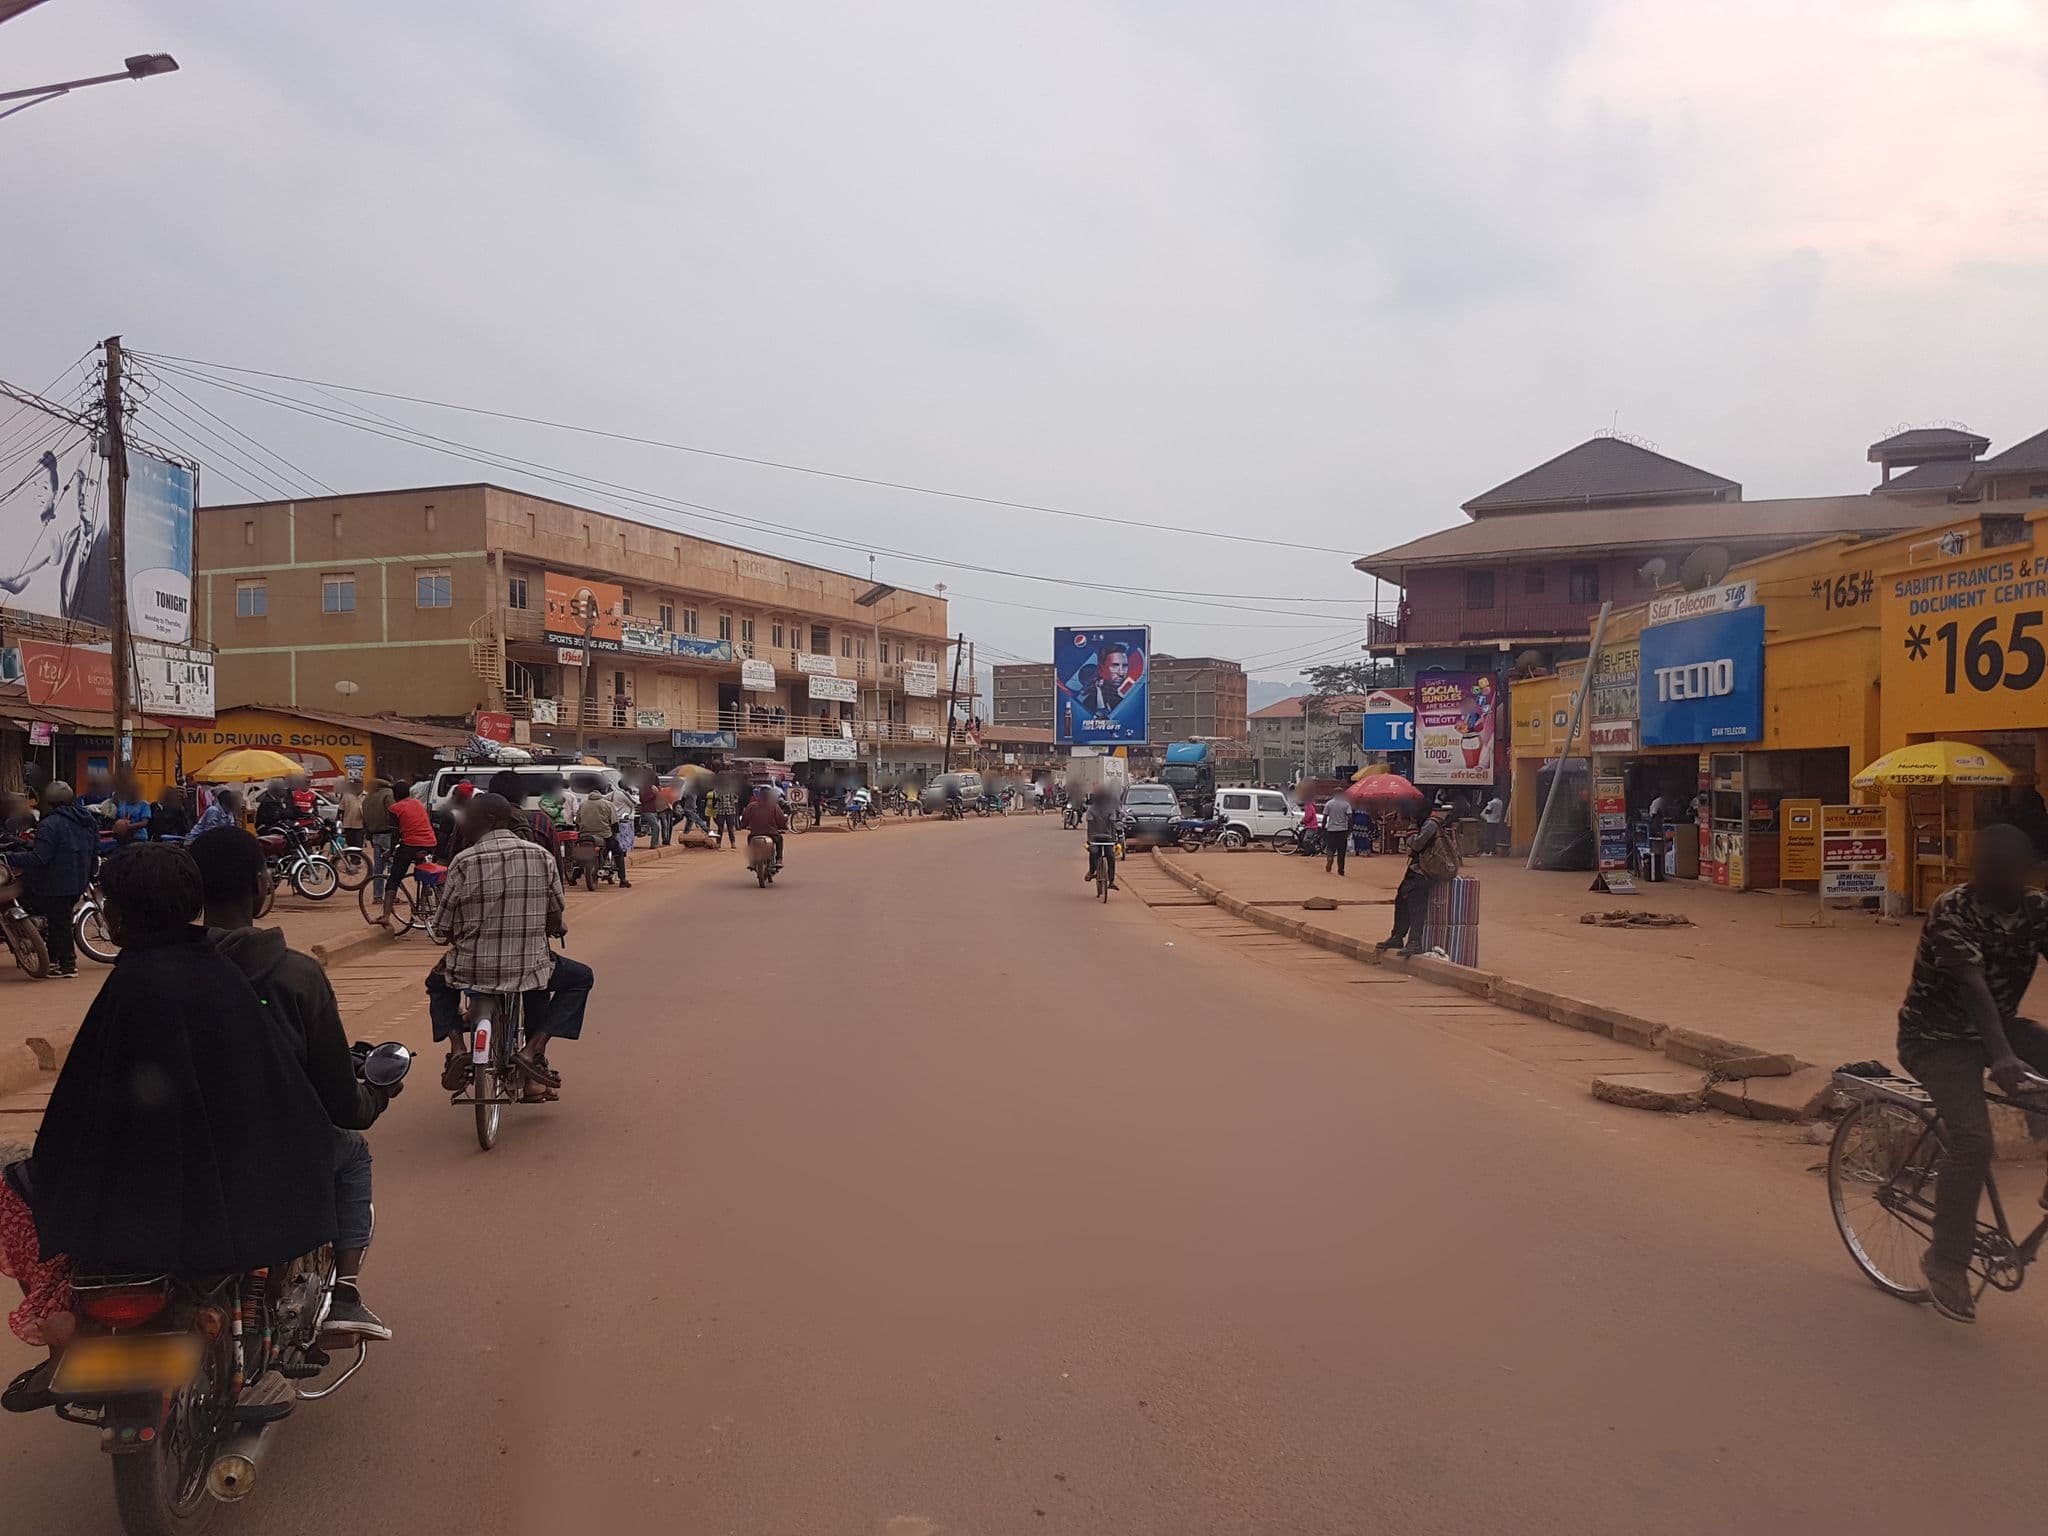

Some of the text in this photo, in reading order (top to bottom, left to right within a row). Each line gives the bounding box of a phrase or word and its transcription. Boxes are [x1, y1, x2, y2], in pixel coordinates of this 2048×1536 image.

[1895, 575, 1943, 598] SABIITI
[1947, 562, 2014, 587] FRANCIS
[2019, 559, 2031, 577] &
[155, 590, 188, 614] TONIGHT
[1652, 593, 1716, 620] Star Telecom
[1910, 579, 2048, 616] DOCUMENT CENTR
[548, 634, 573, 645] SPORTS
[598, 641, 618, 651] AFRICA
[190, 650, 212, 664] WORLD
[1604, 649, 1640, 668] SUPER
[1904, 611, 2048, 695] 165
[38, 659, 62, 680] itel
[1654, 658, 1734, 703] TECNO
[1421, 685, 1462, 696] SOCIAL
[1422, 693, 1462, 703] BUNDLES
[213, 733, 282, 745] DRIVING
[290, 734, 363, 746] SCHOOL
[1424, 734, 1448, 746] 200
[1711, 726, 1747, 736] STAR TELECOM
[1450, 771, 1488, 780] africell
